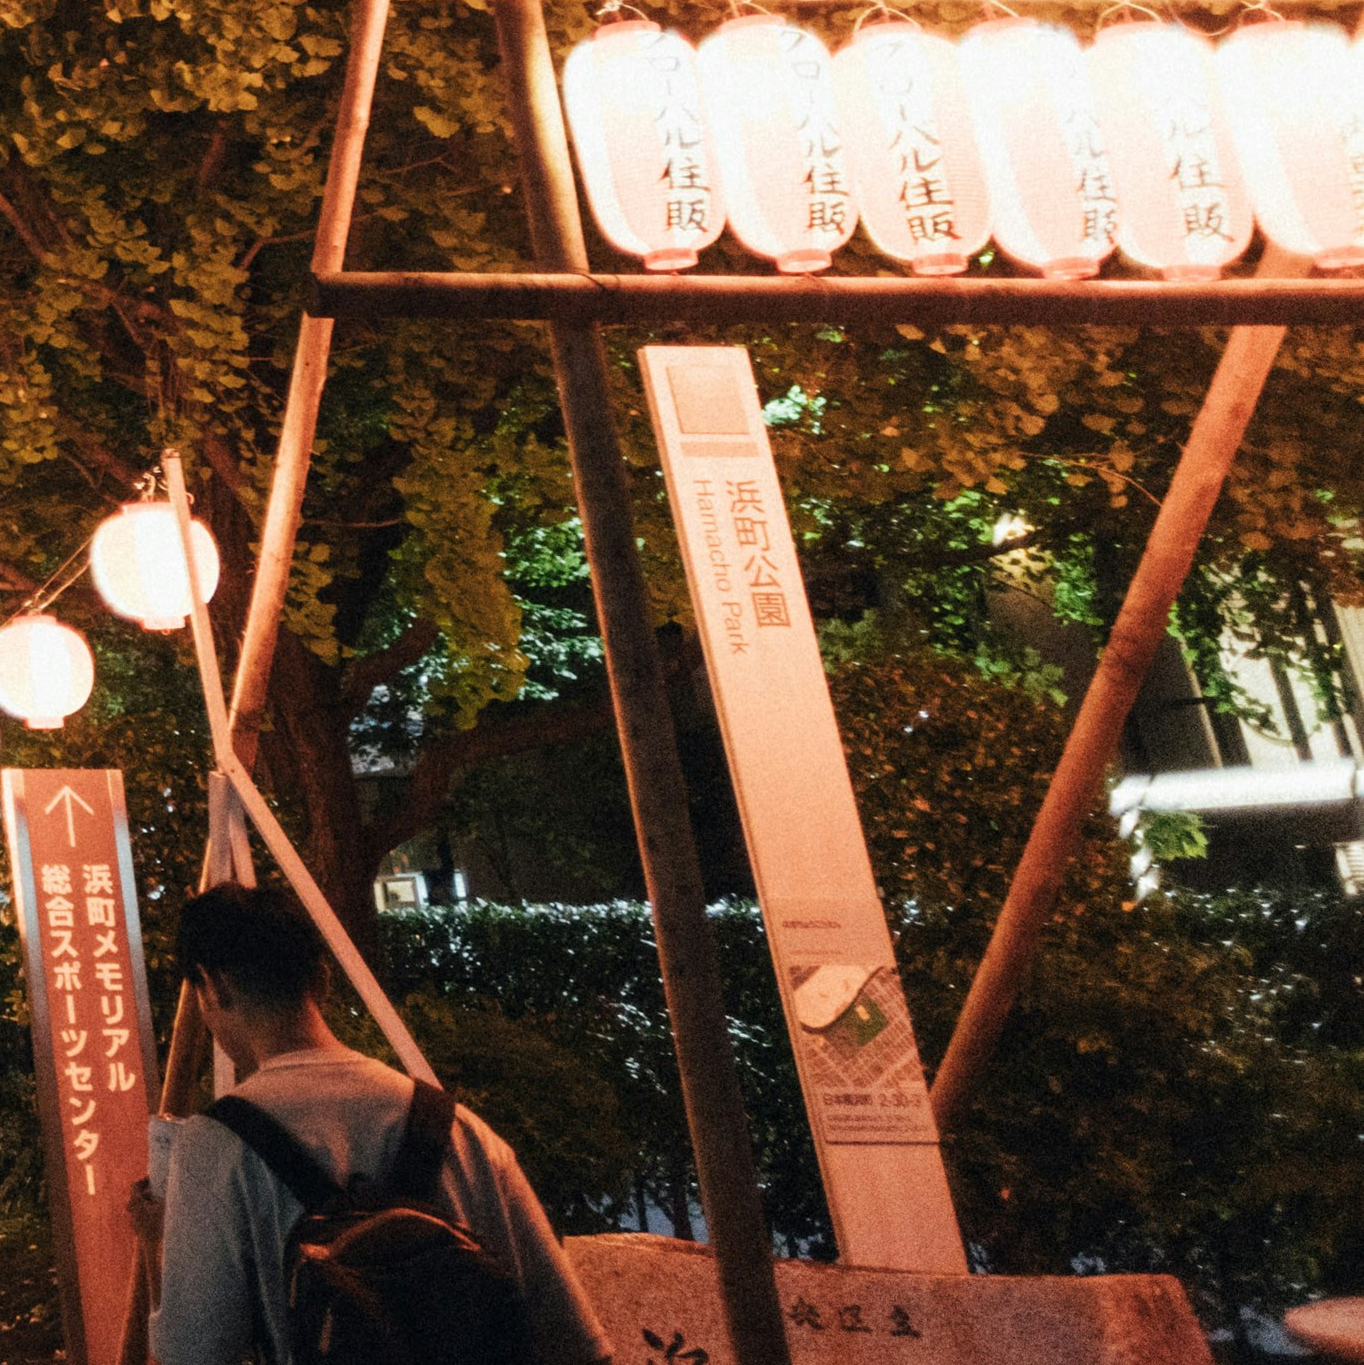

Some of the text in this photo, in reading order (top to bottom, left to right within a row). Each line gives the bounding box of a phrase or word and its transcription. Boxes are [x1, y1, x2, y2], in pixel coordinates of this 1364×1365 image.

[693, 480, 752, 656] Hamacho Park
[726, 480, 792, 628] 浜町公園
[41, 864, 99, 1196] 総合スポーツセンター
[82, 864, 136, 1093] 浜町メモリアル
